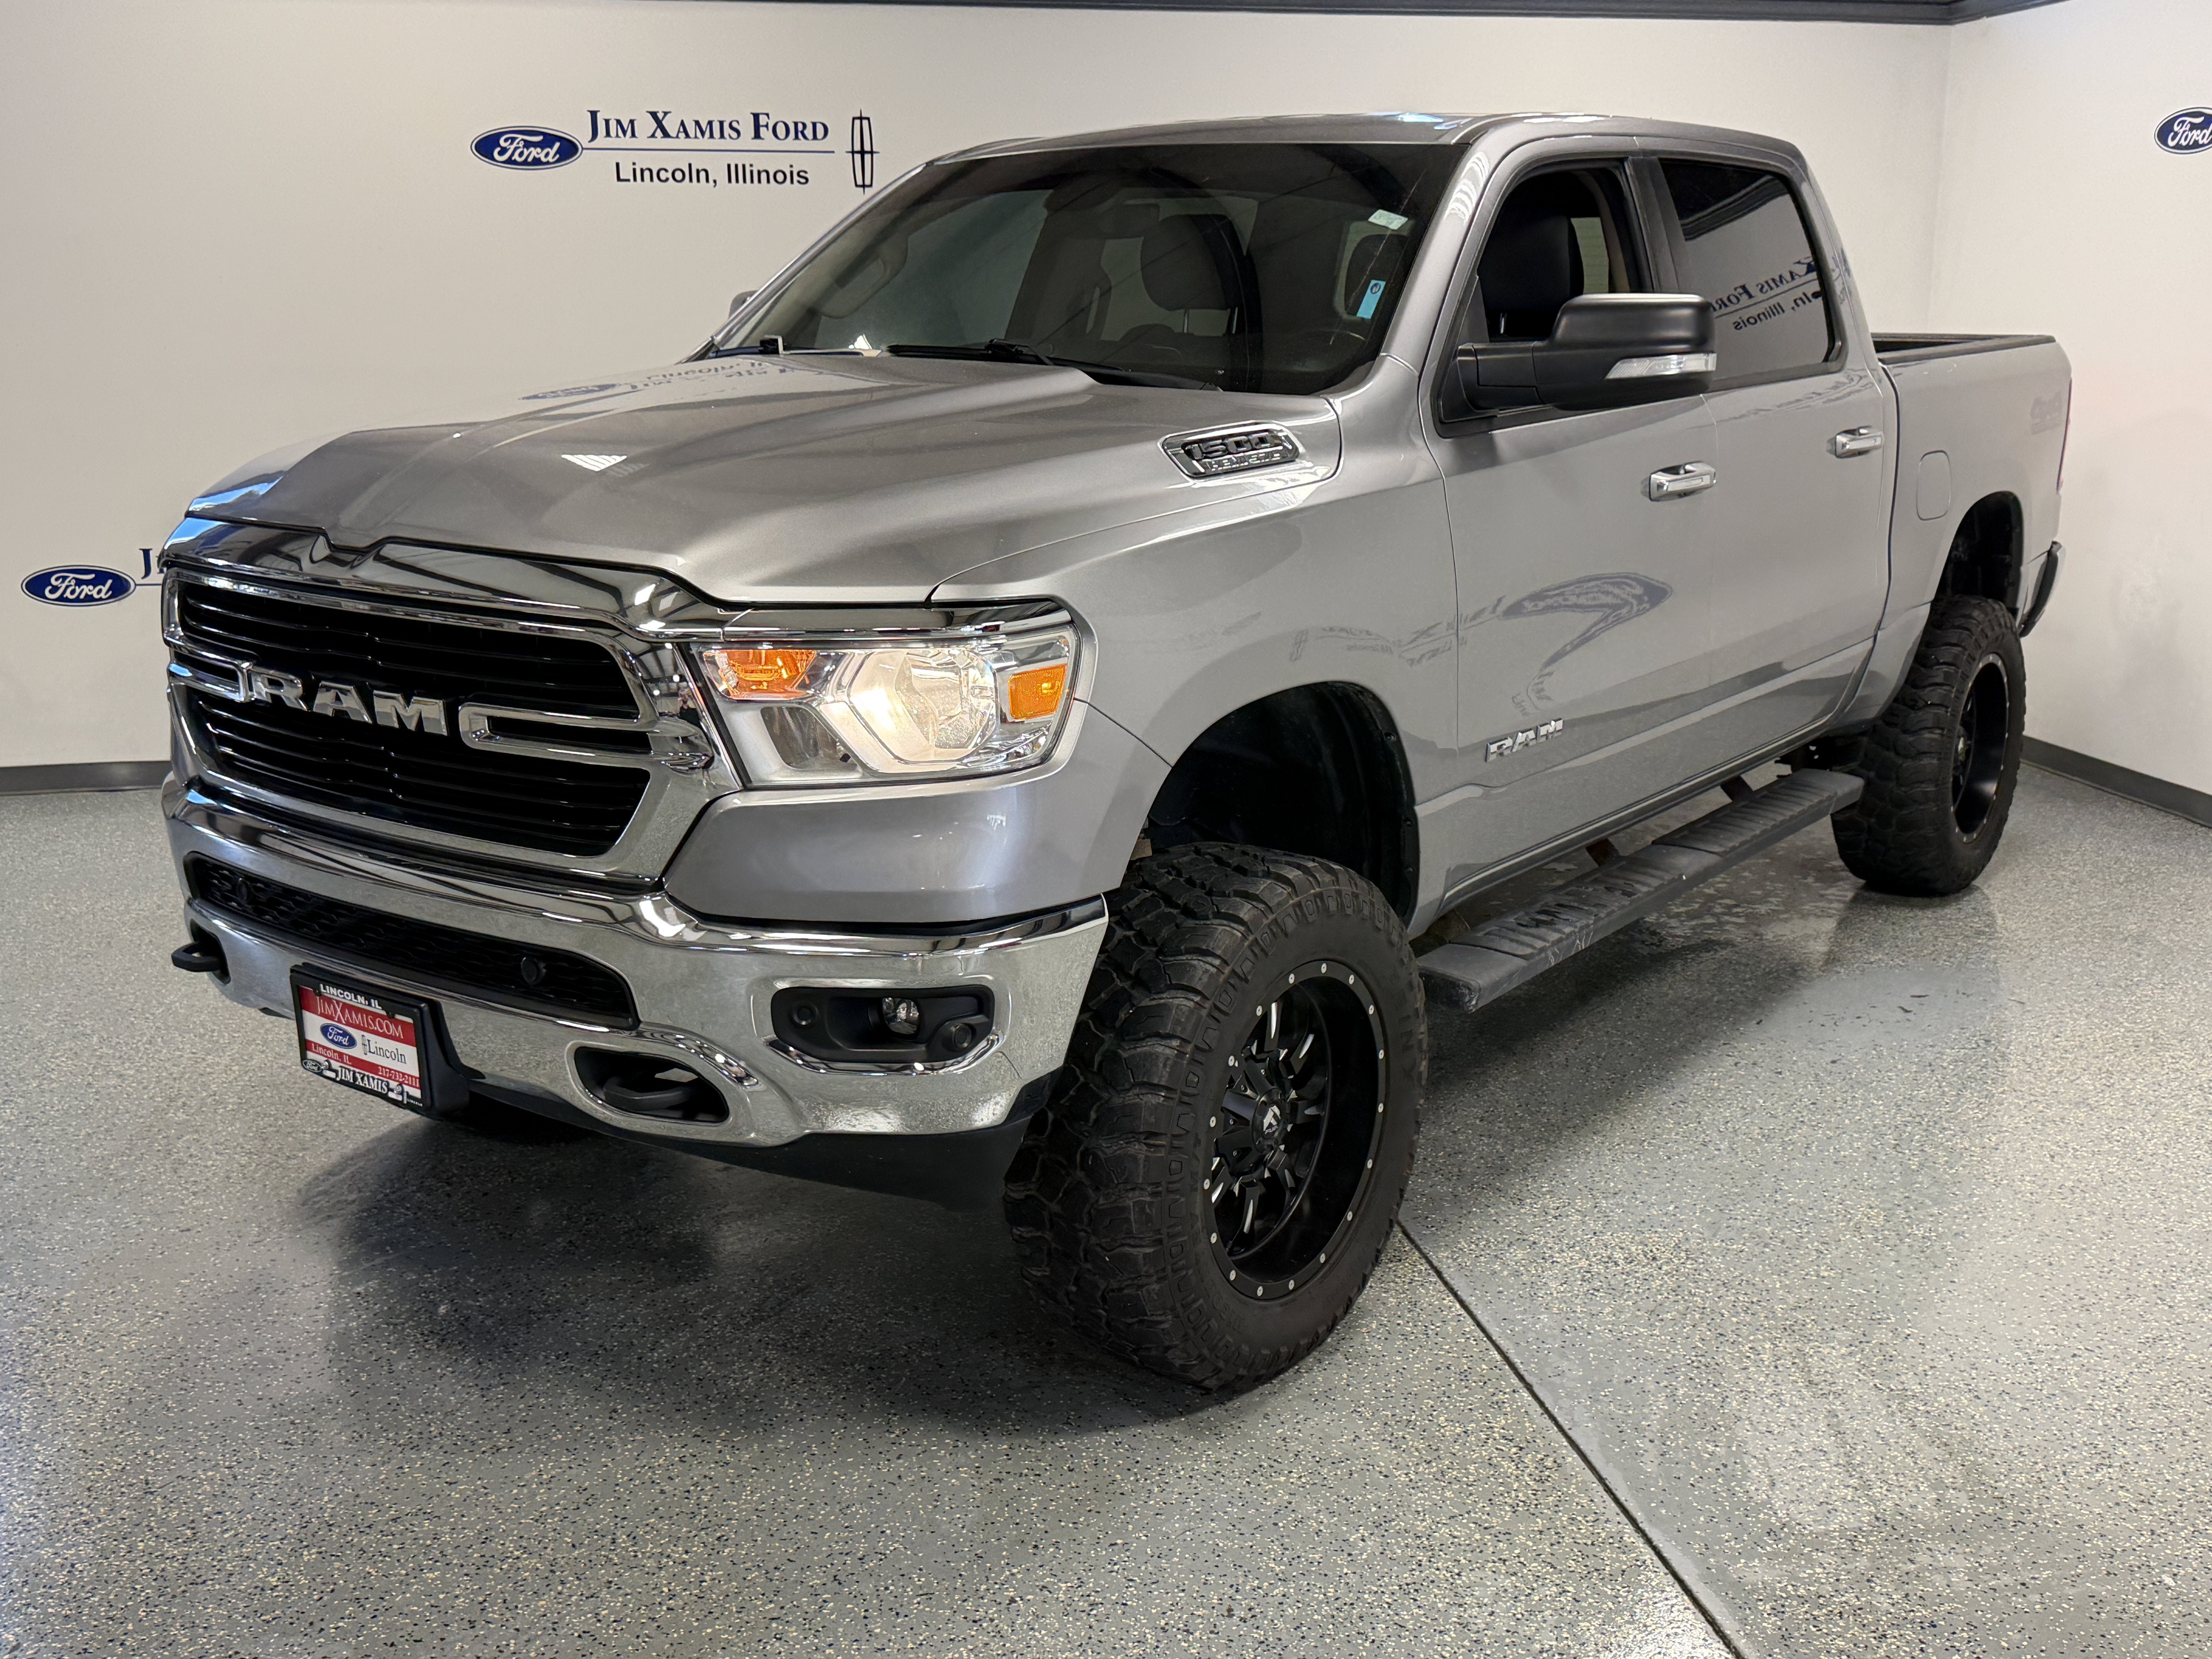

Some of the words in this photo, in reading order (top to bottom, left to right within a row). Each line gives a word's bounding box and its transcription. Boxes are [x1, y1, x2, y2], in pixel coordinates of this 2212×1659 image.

[586, 109, 638, 144] JIM
[646, 110, 742, 141] XAMIS
[750, 112, 829, 142] FORD
[2167, 116, 2212, 147] Ford
[493, 134, 560, 164] Ford
[615, 162, 718, 187] Lincoln,
[726, 163, 810, 185] Illinois
[45, 573, 113, 599] Ford
[252, 667, 449, 736] RAM
[1485, 718, 1563, 763] RAM
[320, 984, 368, 1005] LINCOLN,
[371, 998, 382, 1009] IL
[327, 1026, 350, 1046] Ford
[312, 1043, 342, 1062] Lincoln,
[367, 1038, 407, 1065] Lincoln
[336, 1065, 354, 1083] JIM
[355, 1073, 388, 1094] XAMIS
[378, 1066, 419, 1087] 217-732-2111
